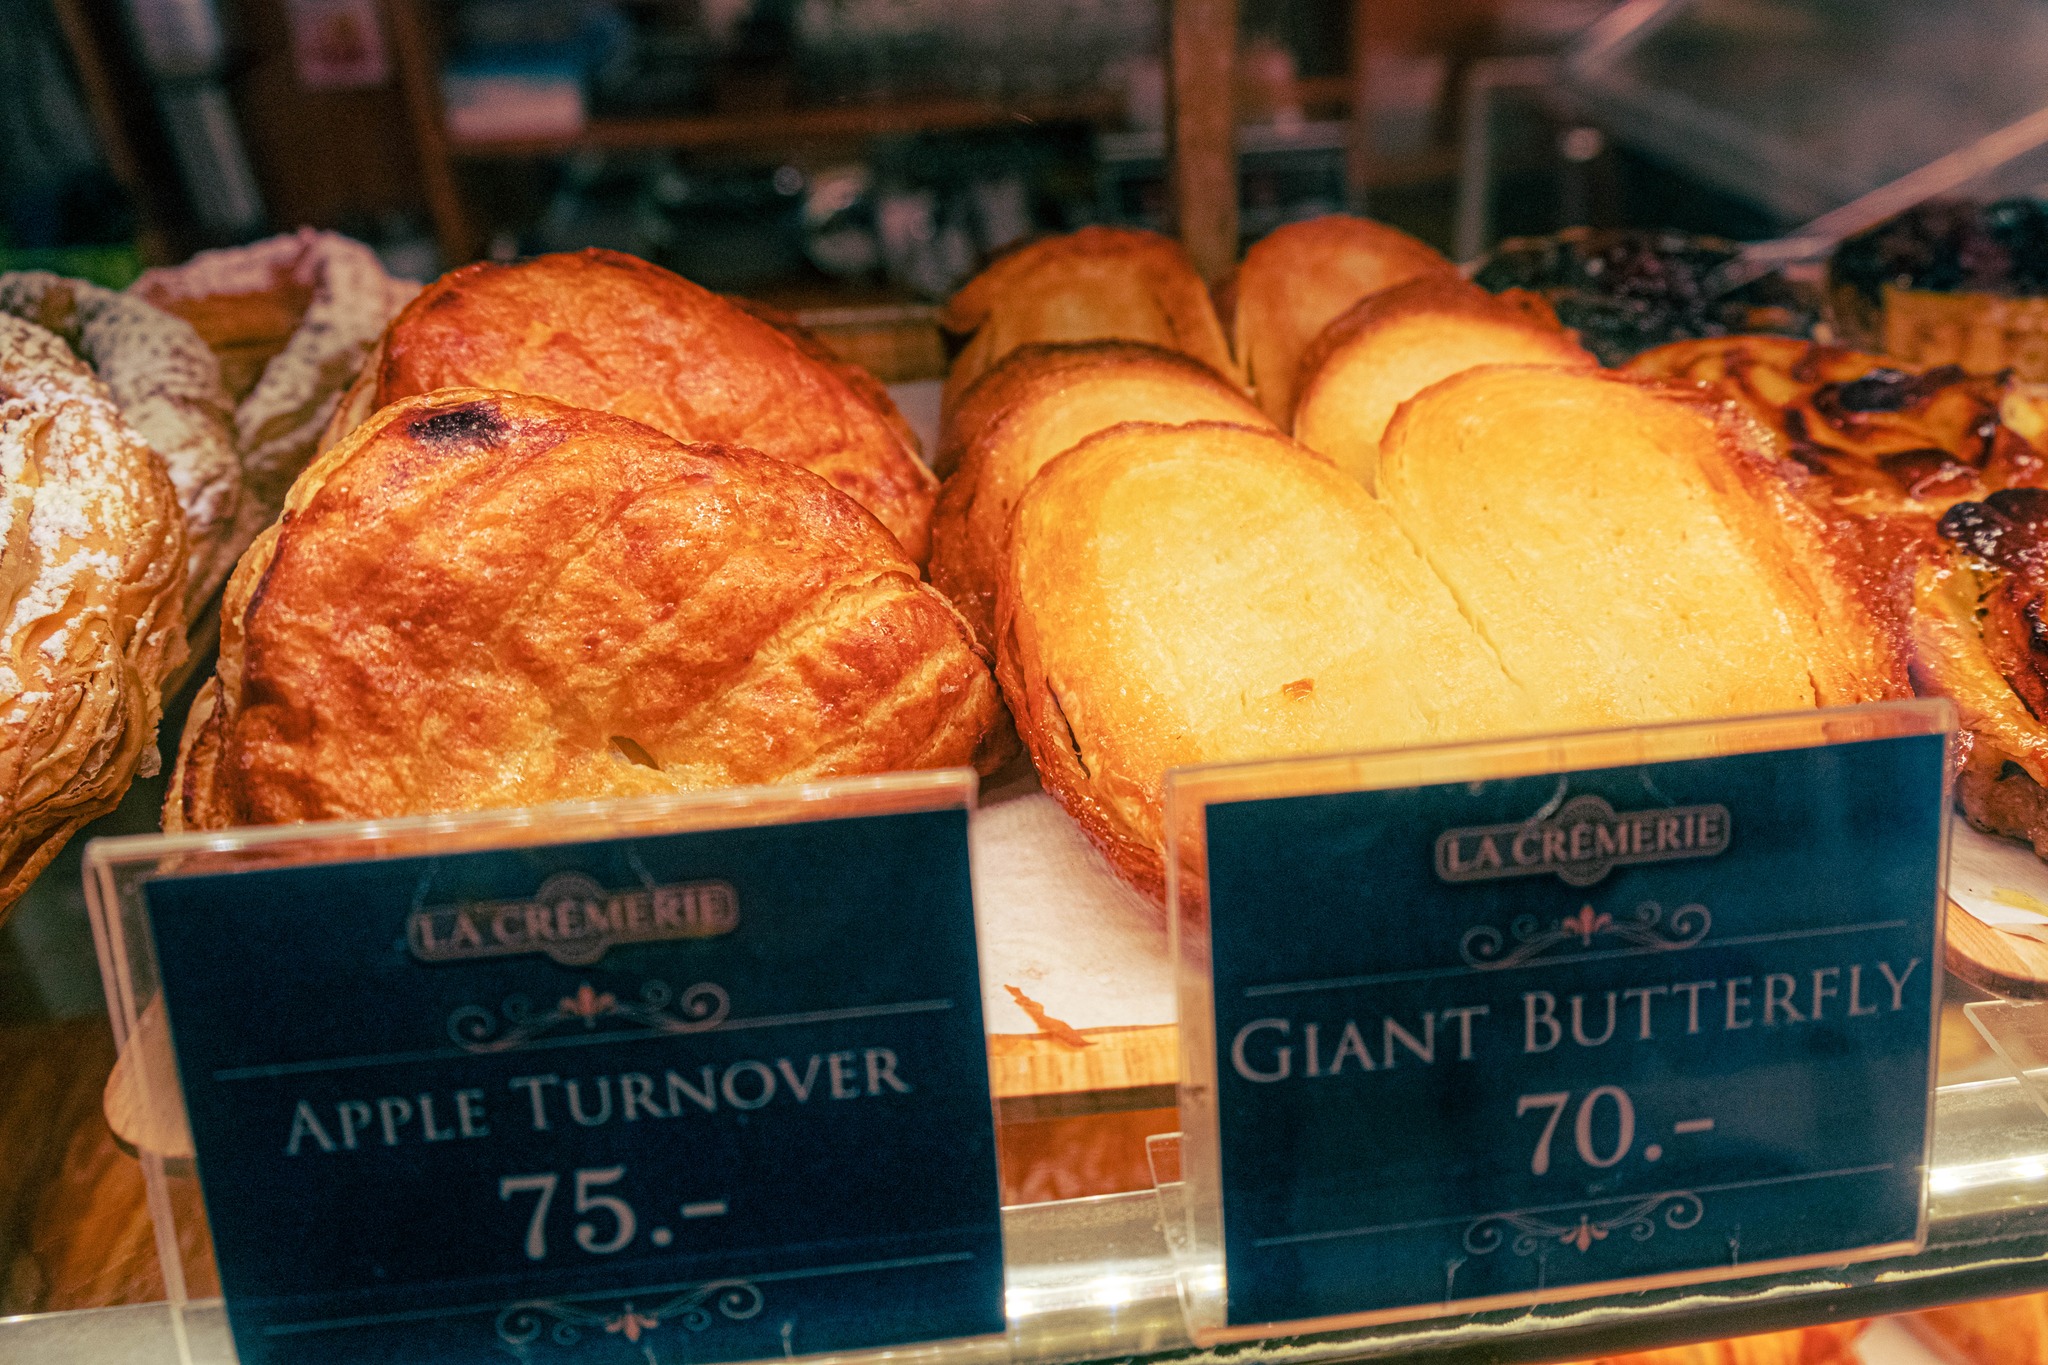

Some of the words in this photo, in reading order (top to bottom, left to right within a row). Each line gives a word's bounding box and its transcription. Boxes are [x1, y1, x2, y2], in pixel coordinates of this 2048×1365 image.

[1449, 834, 1502, 873] LA
[416, 910, 482, 951] LA
[1231, 1008, 1490, 1083] GIANT
[1524, 958, 1921, 1054] BUTTERFLY
[286, 1090, 490, 1156] APPLE
[511, 1048, 911, 1130] TURNOVER
[1516, 1087, 1715, 1176] 70.-
[500, 1166, 727, 1260] 75.-
